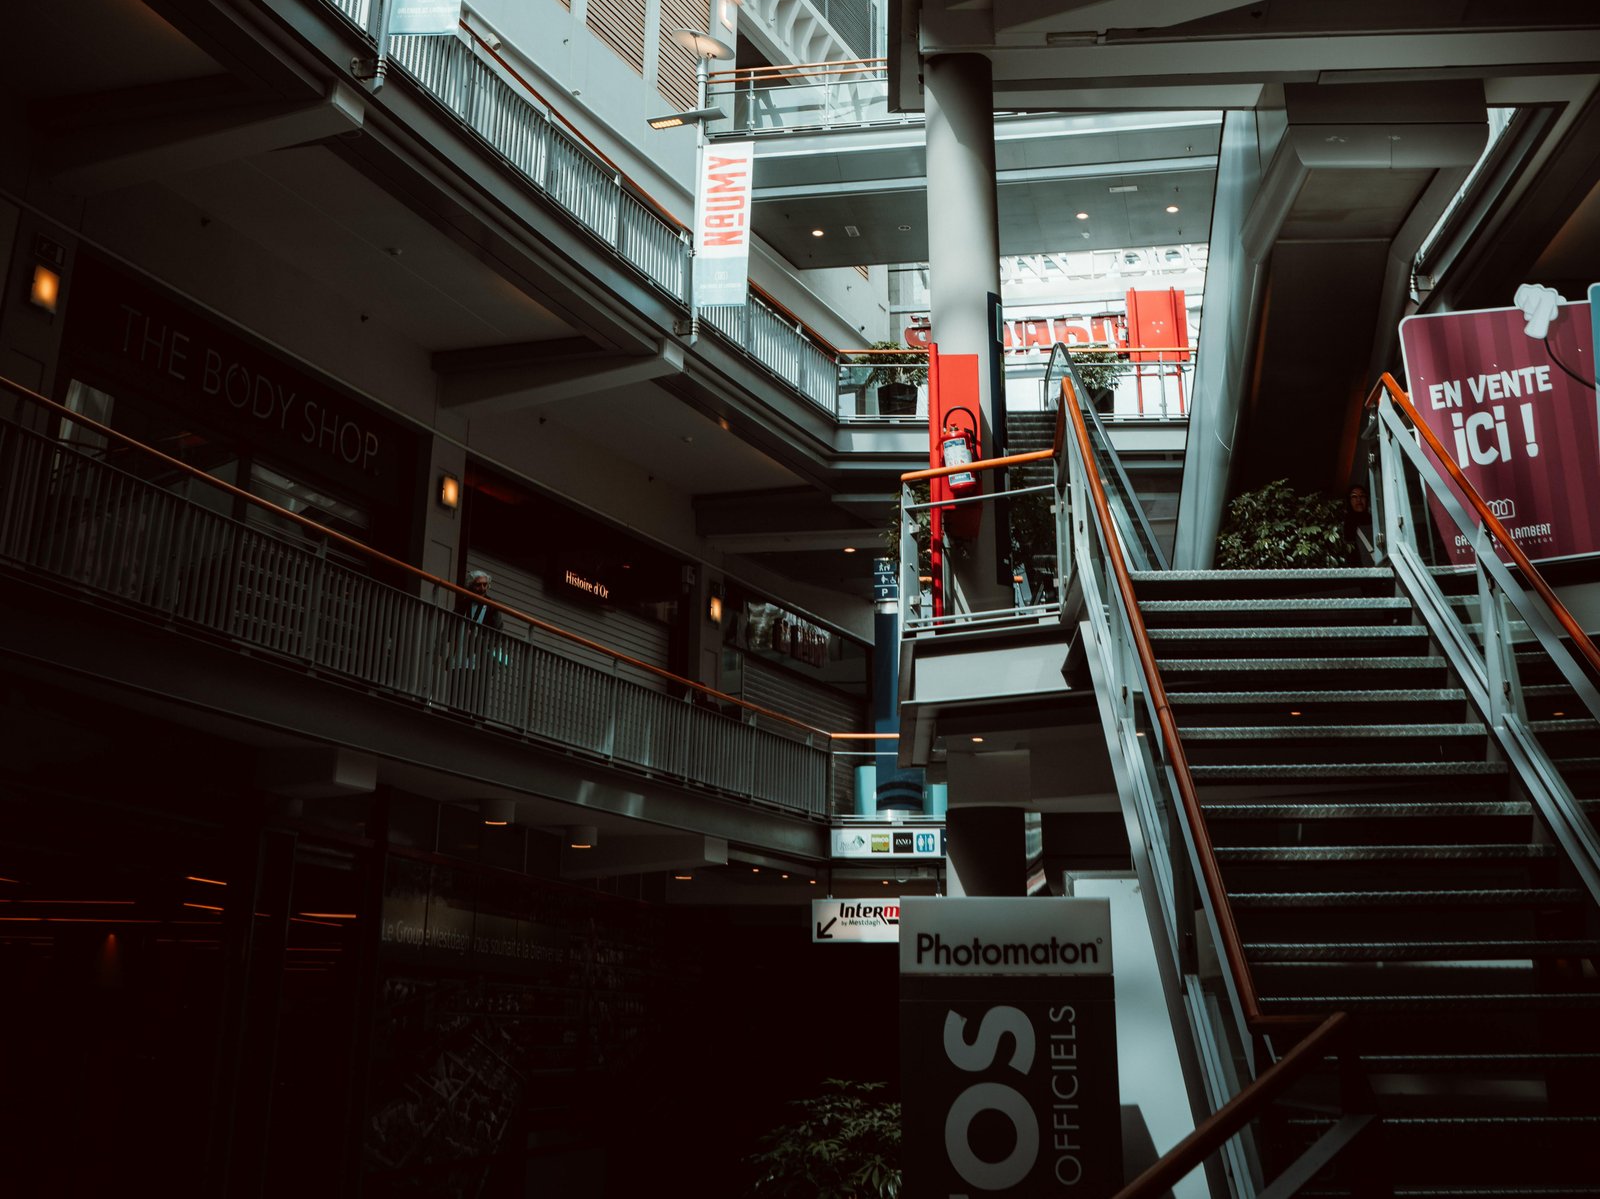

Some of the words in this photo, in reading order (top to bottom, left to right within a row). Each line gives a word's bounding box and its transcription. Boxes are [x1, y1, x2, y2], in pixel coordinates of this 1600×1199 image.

[120, 303, 190, 380] THE
[202, 348, 296, 432] BODY
[301, 400, 379, 470] SHOP
[1429, 380, 1463, 410] EN
[1467, 365, 1552, 404] VENTE
[1510, 523, 1551, 540] LAMBERT
[565, 570, 593, 593] Histoire
[593, 581, 609, 599] d'Or
[881, 588, 889, 597] P
[381, 919, 394, 942] Le
[396, 920, 431, 951] Groupe
[848, 919, 881, 927] Mestdagh
[917, 933, 1098, 966] Photomaton
[943, 1004, 1040, 1199] OS
[1049, 1004, 1083, 1186] OFFICIELS
